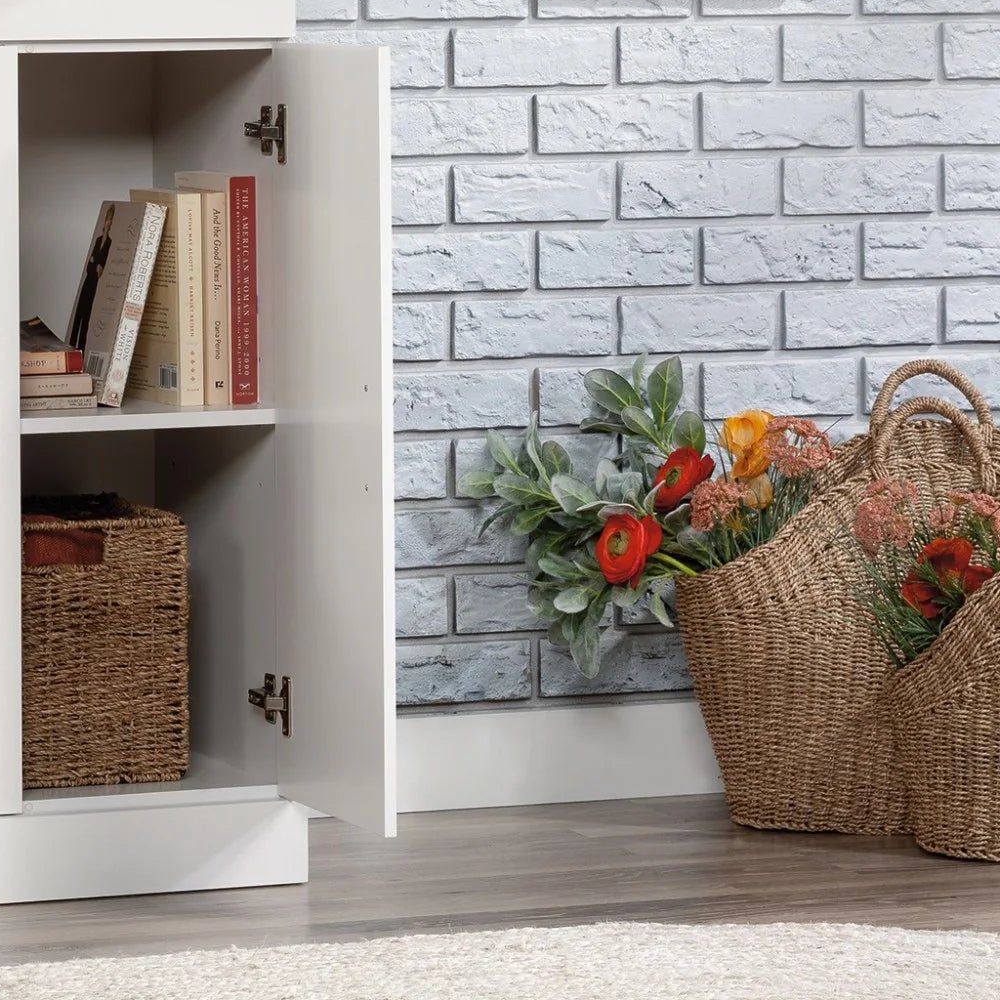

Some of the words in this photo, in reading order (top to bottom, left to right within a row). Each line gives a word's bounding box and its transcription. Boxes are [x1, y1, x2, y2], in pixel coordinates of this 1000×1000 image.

[145, 215, 161, 247] NORA
[213, 209, 221, 226] And
[213, 226, 221, 238] the
[242, 215, 250, 271] AMERICAN
[213, 239, 222, 261] Good
[132, 250, 153, 302] ROBERTS
[214, 261, 222, 283] News
[115, 334, 127, 361] WHITE
[123, 329, 135, 361] VISION
